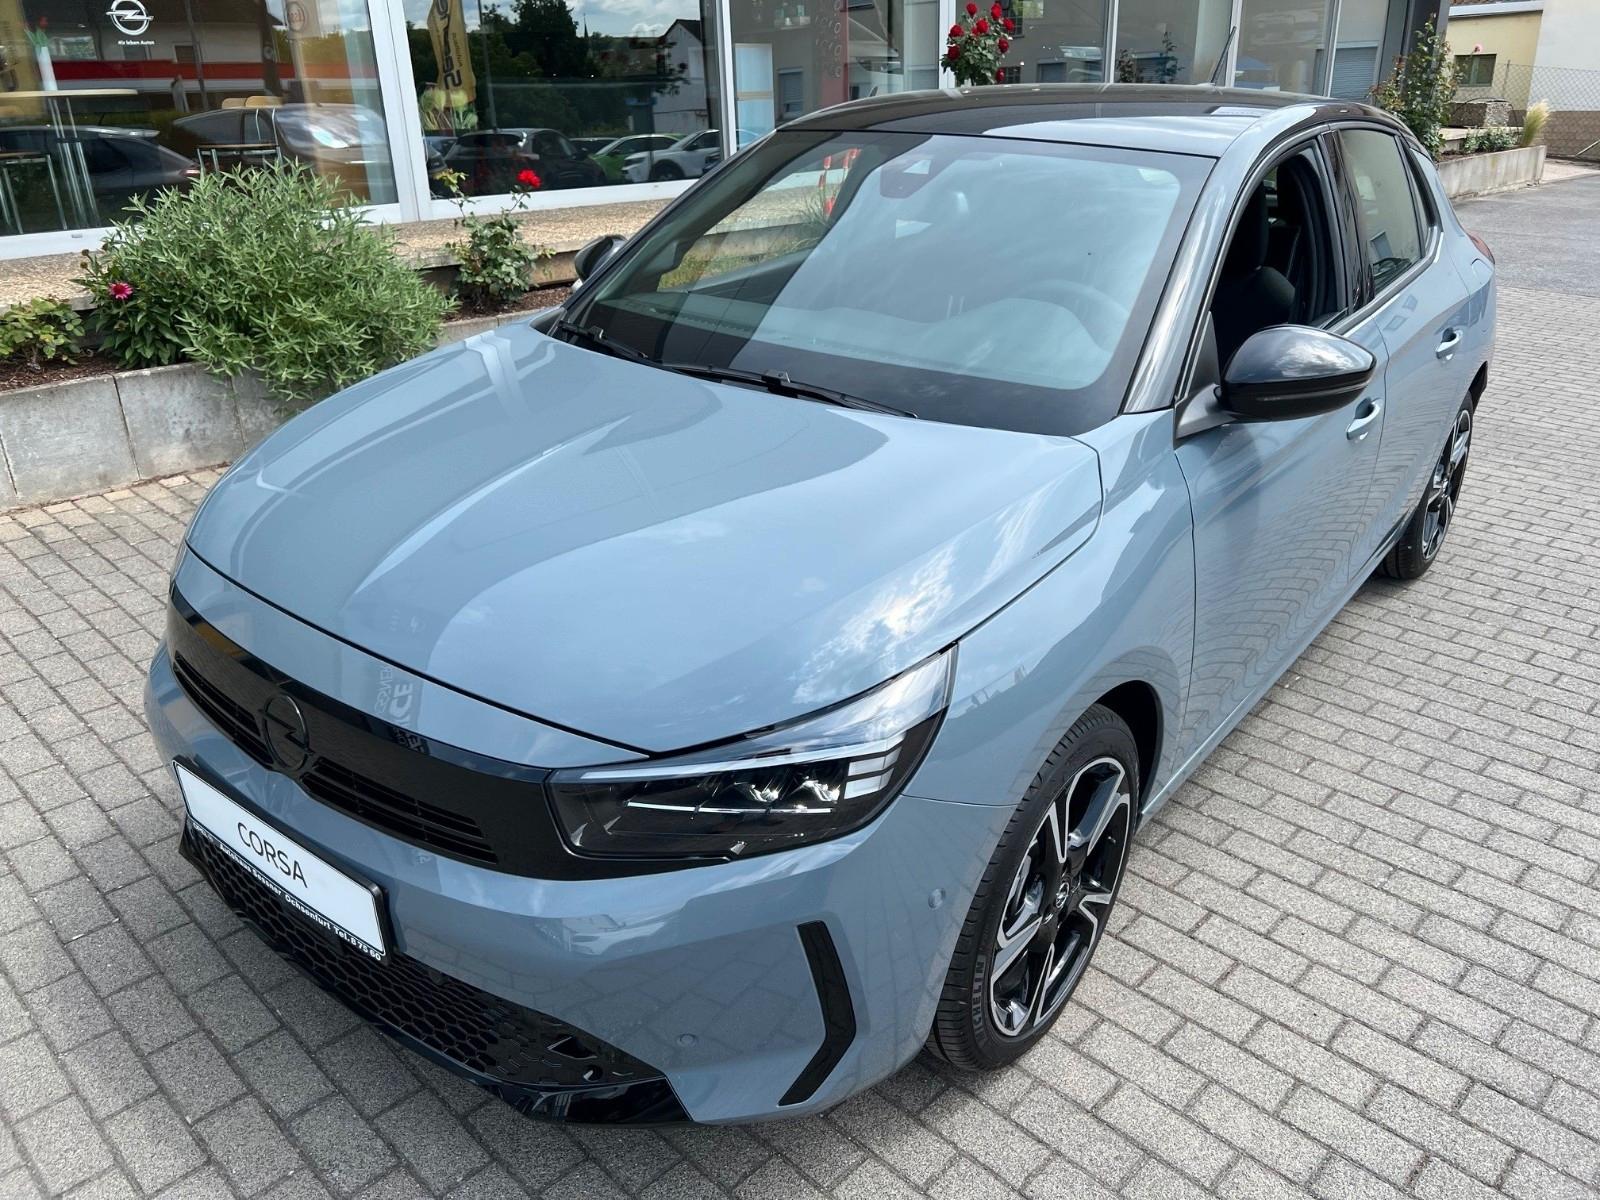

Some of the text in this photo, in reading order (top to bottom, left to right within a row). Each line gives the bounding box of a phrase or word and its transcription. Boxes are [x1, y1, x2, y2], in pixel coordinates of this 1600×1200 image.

[237, 822, 308, 888] CORSA
[285, 894, 332, 930] Ochsenfurt
[971, 958, 986, 1045] MICHELIN
